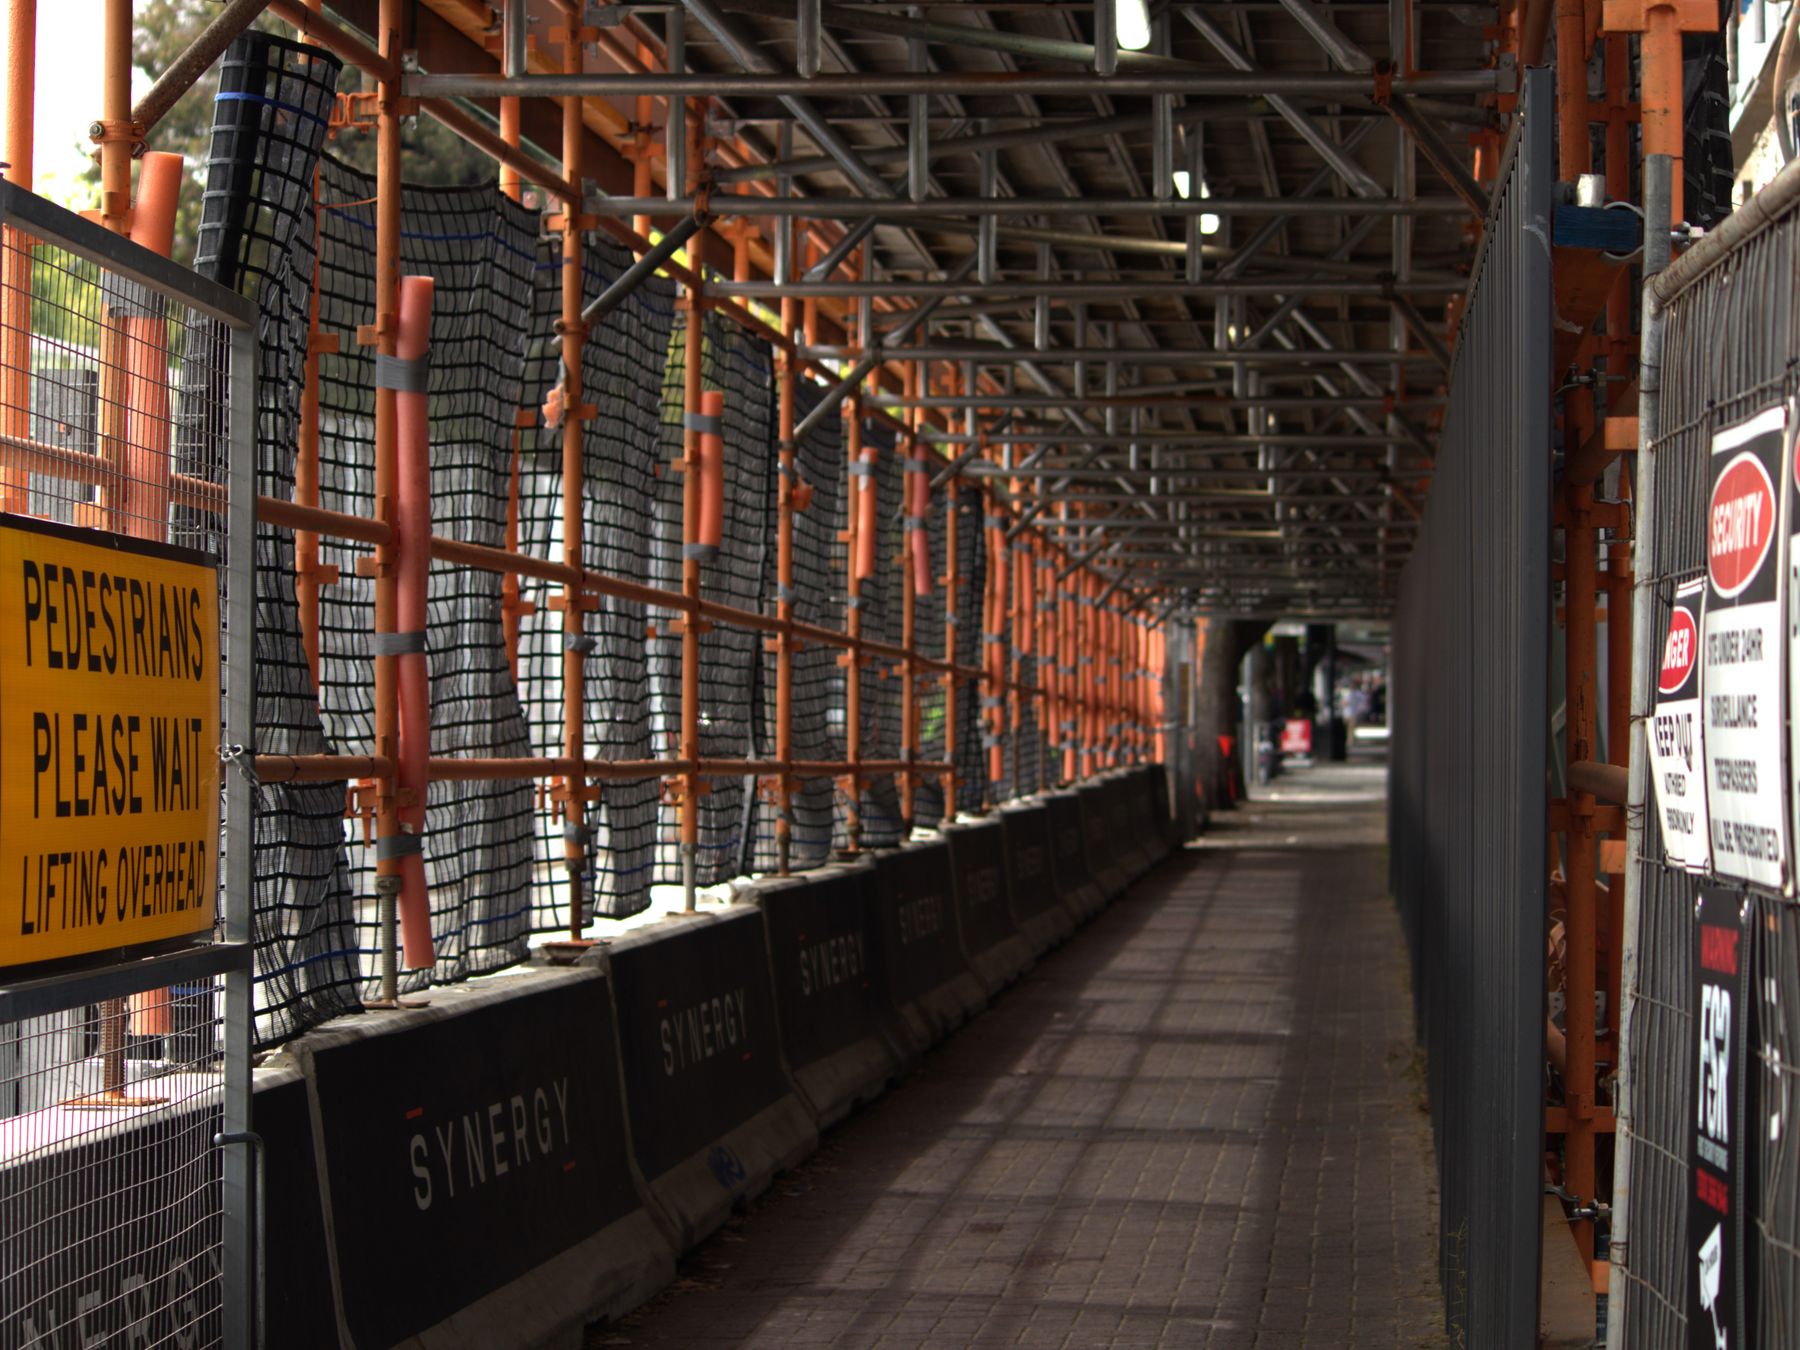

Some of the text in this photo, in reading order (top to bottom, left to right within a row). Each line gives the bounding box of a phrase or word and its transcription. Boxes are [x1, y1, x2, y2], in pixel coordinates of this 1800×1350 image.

[1711, 490, 1764, 558] SECURITY
[22, 559, 204, 682] PEDESTRIANS
[1662, 627, 1690, 670] NGER
[33, 711, 203, 819] PLEASE WAIT
[1653, 713, 1693, 757] KEEP OUT
[21, 840, 206, 936] LIFTING OVERHEAD
[801, 929, 868, 997] SYNERGY
[659, 986, 748, 1078] SYNERGY
[409, 1077, 568, 1211] SYNERGY
